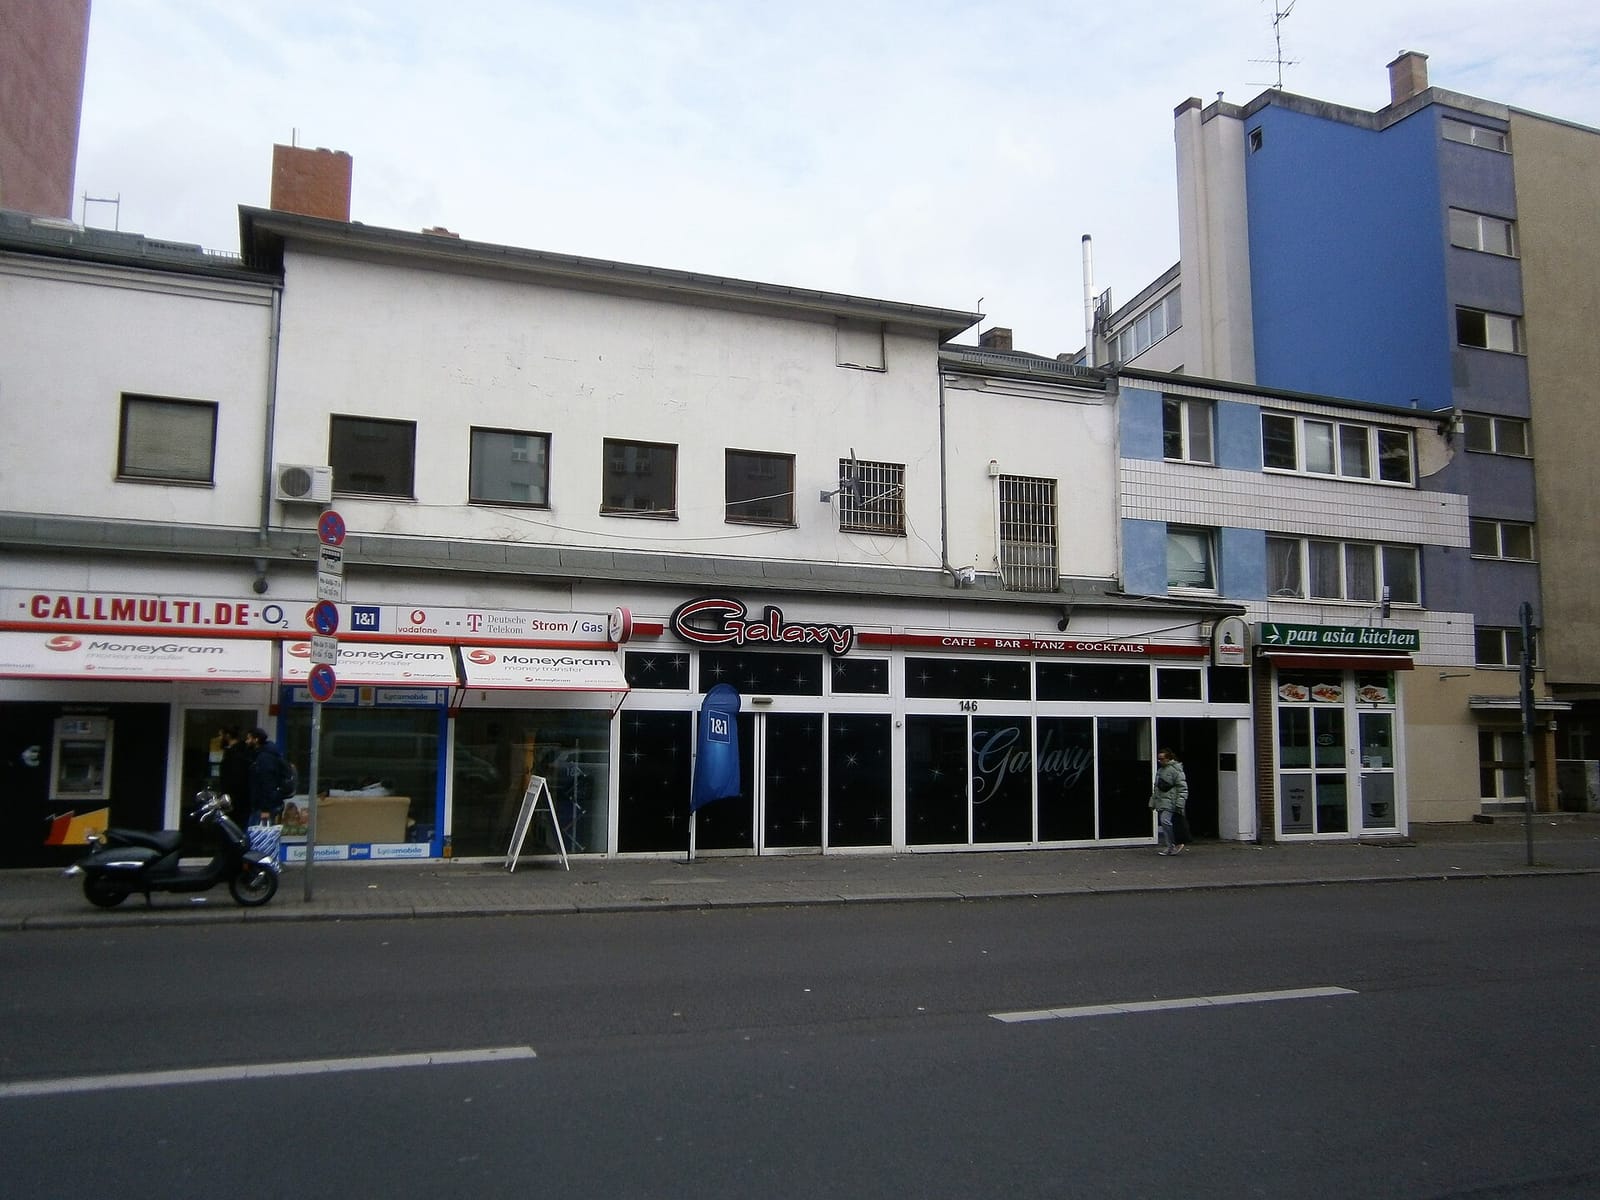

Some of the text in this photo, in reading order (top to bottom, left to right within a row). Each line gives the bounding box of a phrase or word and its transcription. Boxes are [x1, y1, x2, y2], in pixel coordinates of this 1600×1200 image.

[30, 594, 249, 626] CALLMULTI.DE
[353, 612, 376, 627] 1&1
[487, 614, 527, 625] Deutsche
[532, 619, 569, 633] Strom
[581, 621, 604, 634] Gas
[675, 599, 852, 654] Galaxy
[398, 626, 438, 635] vodafone
[487, 624, 524, 635] Telekom
[1285, 627, 1416, 645] pan asia kitchen
[87, 641, 224, 655] MoneyGram
[942, 637, 976, 647] CAFE
[995, 639, 1021, 649] BAR
[1032, 640, 1065, 650] TANZ
[1076, 642, 1145, 653] COCKTAILS
[502, 655, 611, 667] MoneyGram
[542, 666, 584, 674] transfer
[959, 700, 978, 712] 146
[710, 717, 729, 735] 1&1
[966, 727, 1093, 804] Galaxy
